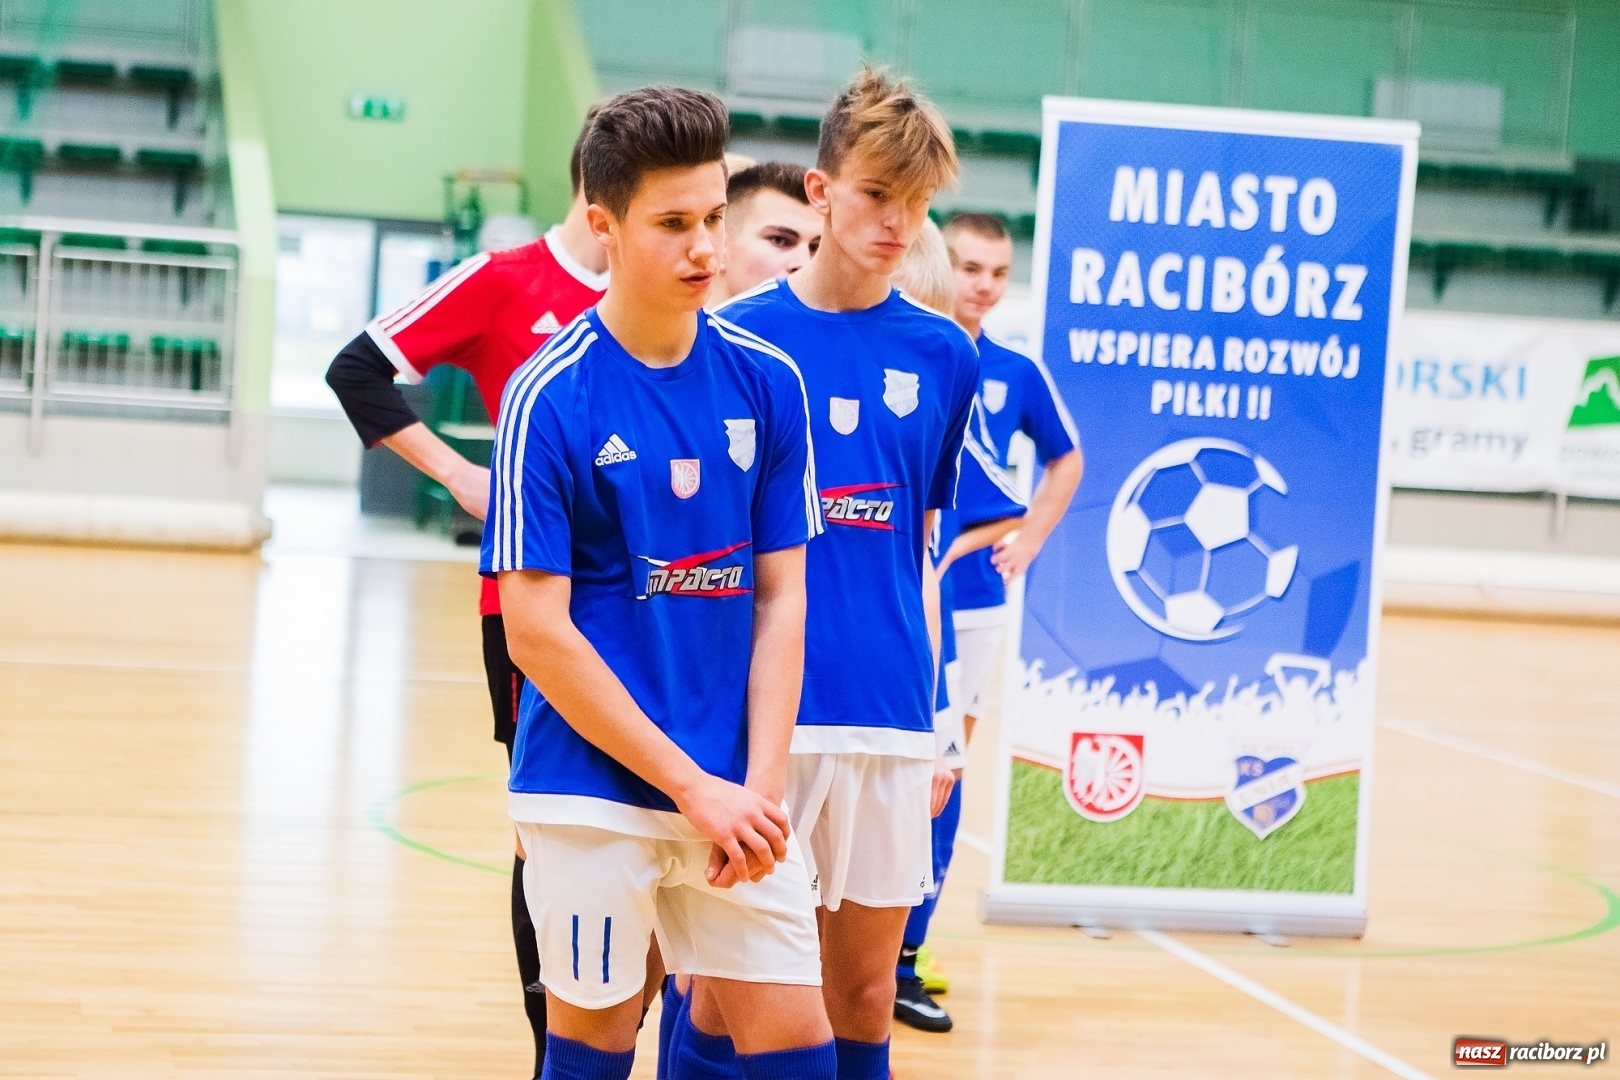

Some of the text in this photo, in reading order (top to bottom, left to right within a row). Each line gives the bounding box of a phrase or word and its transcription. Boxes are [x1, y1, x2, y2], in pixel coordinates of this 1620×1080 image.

[1108, 165, 1338, 236] MIASTO
[1069, 244, 1368, 321] RACIBÓRZ
[1068, 328, 1361, 379] WSPIERA ROZWÓJ
[1151, 379, 1272, 421] PIŁKI !!
[594, 450, 638, 466] adidas
[1410, 428, 1530, 462] gramy
[572, 914, 612, 984] 11
